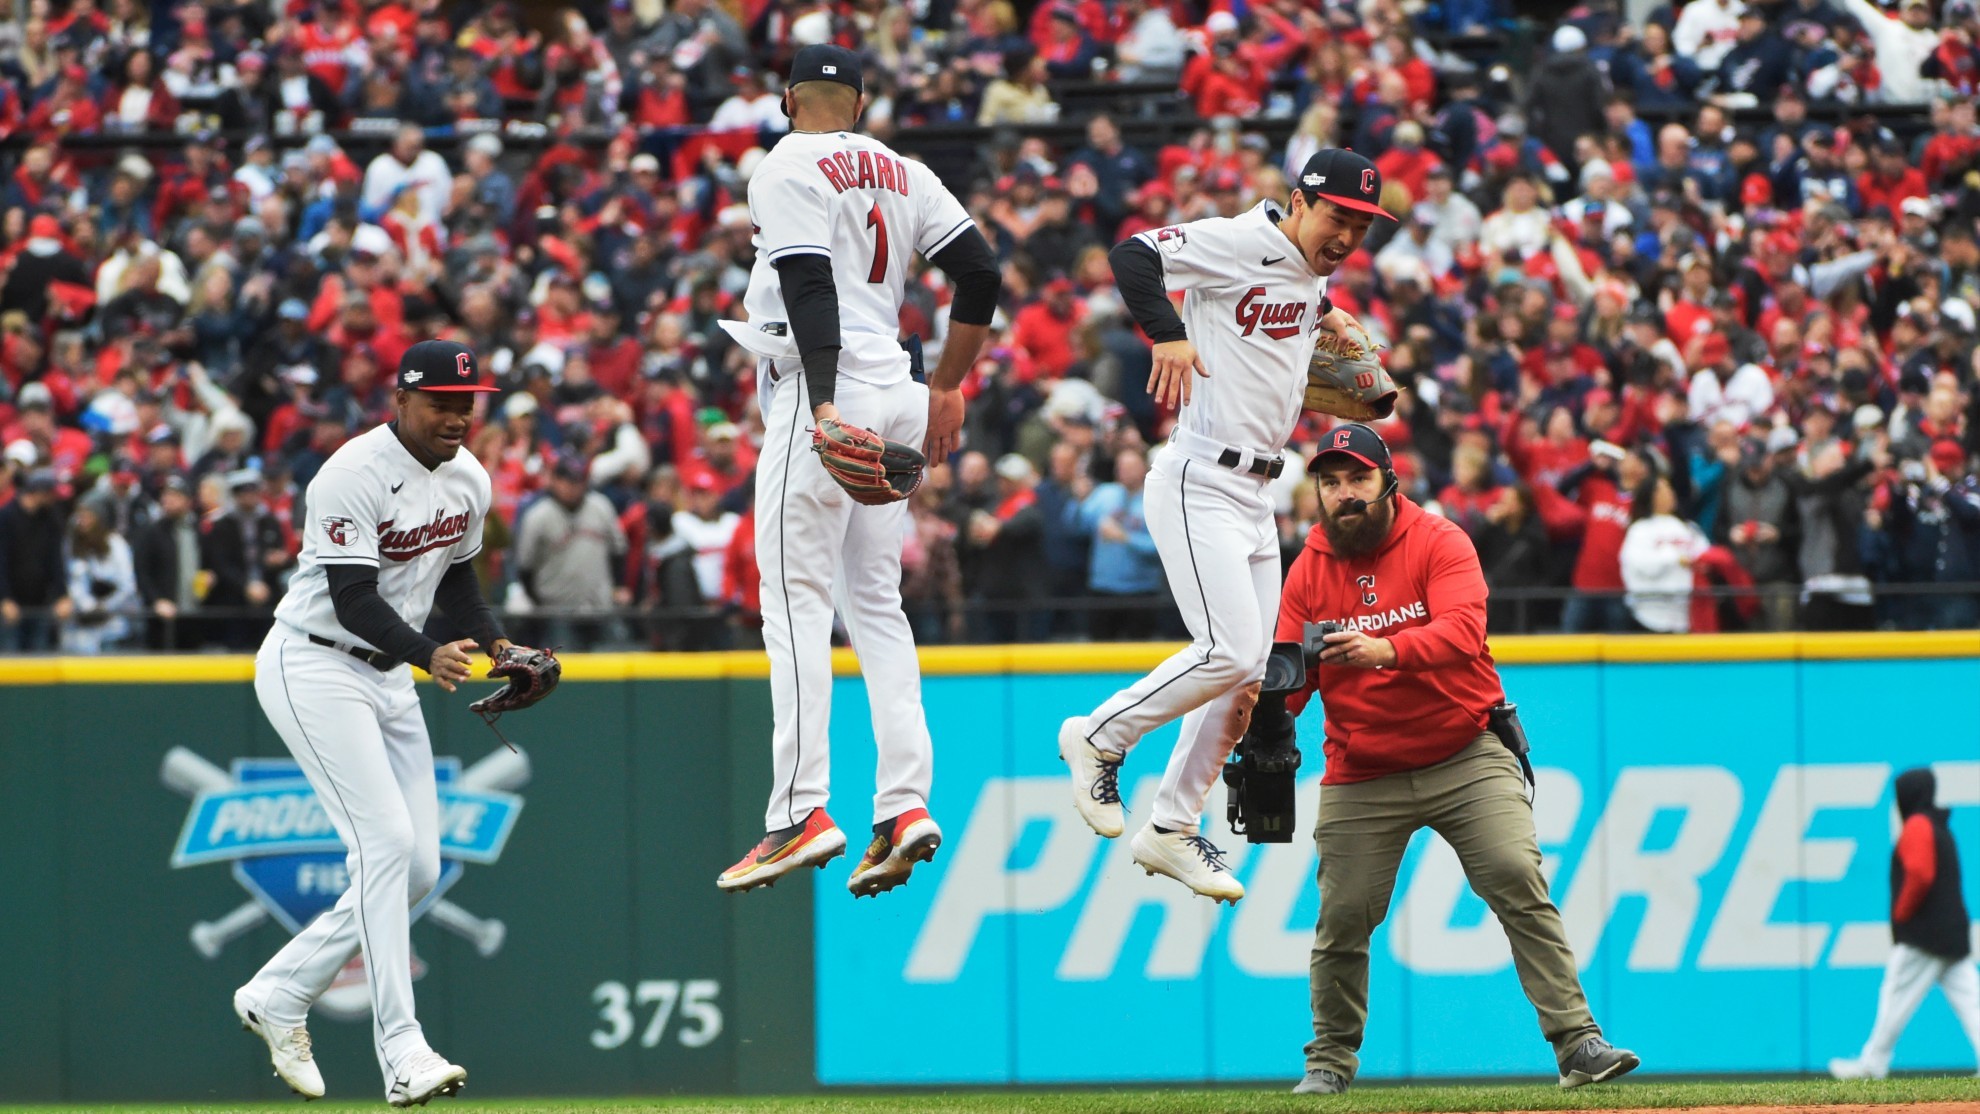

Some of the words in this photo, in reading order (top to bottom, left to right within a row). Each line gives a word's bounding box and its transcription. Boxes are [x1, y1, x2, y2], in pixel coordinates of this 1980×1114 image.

[1360, 168, 1376, 195] C
[866, 200, 888, 283] 1
[455, 352, 471, 378] C
[1333, 430, 1352, 449] C
[1356, 574, 1378, 606] C
[590, 979, 723, 1049] 375
